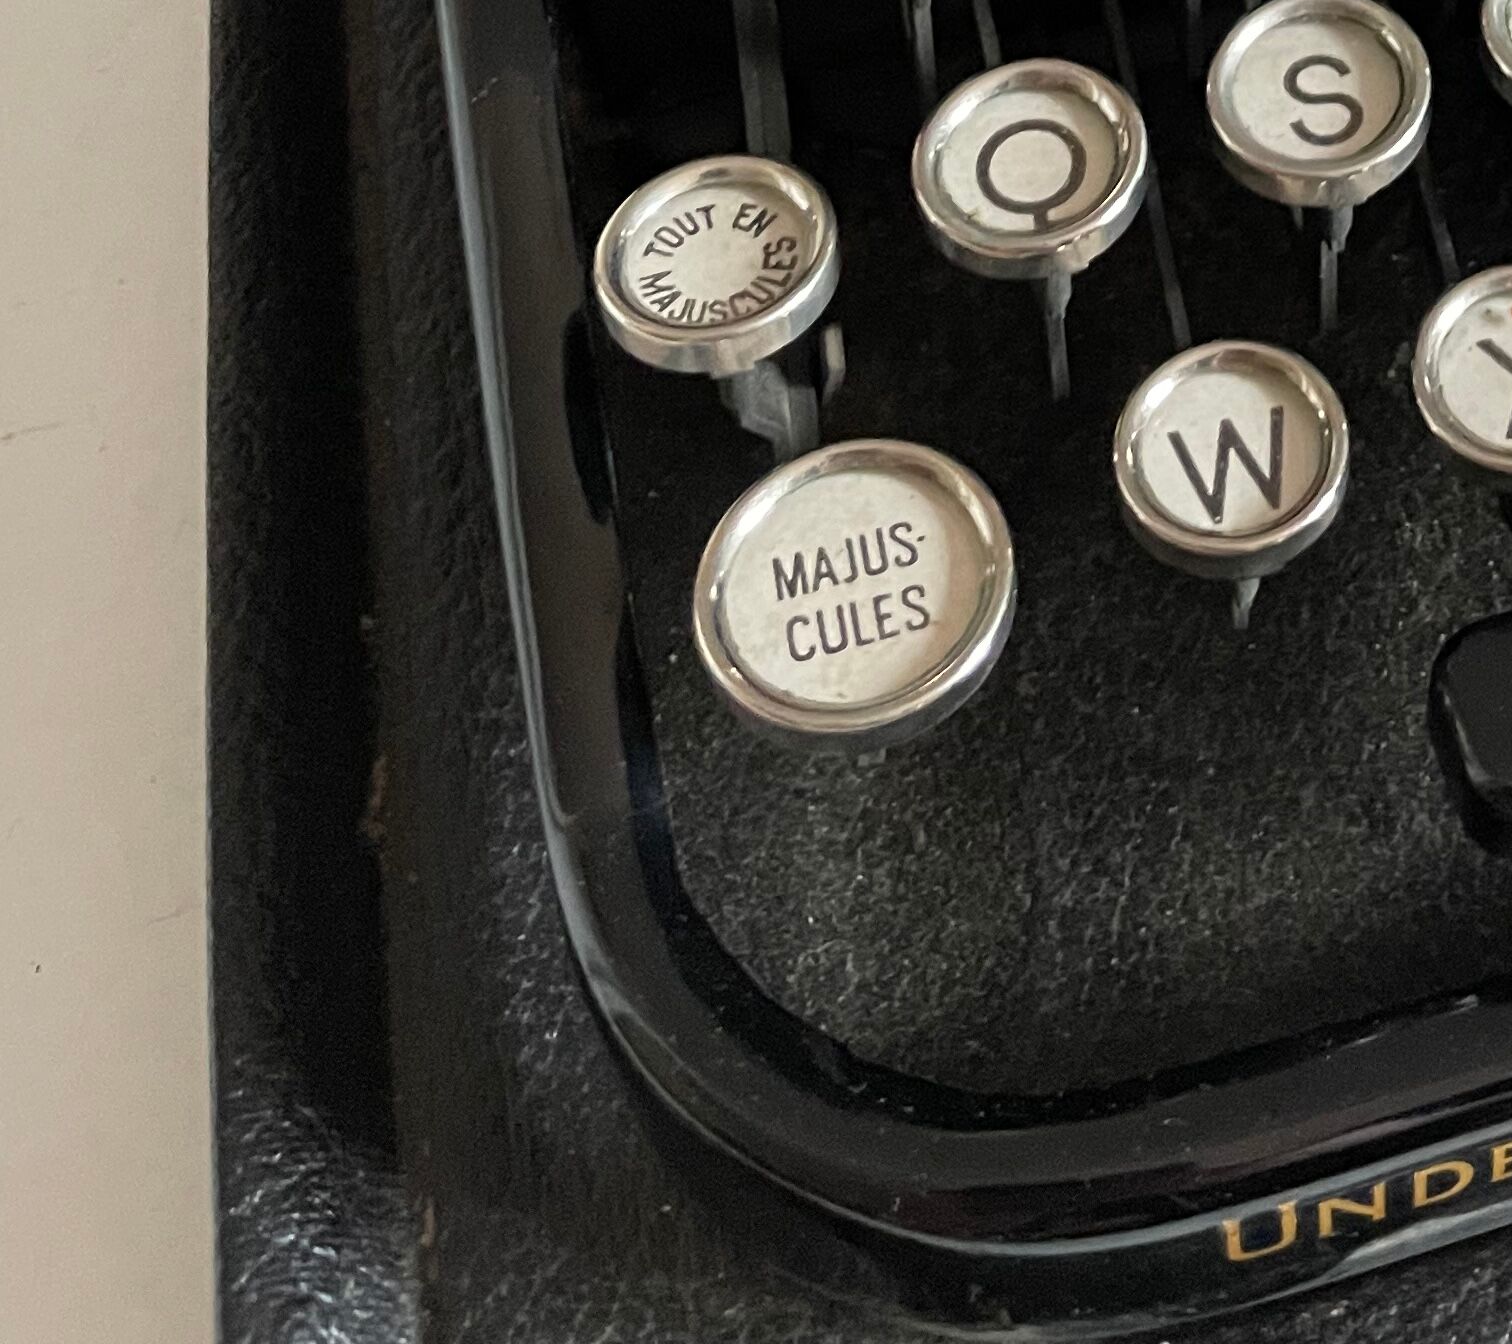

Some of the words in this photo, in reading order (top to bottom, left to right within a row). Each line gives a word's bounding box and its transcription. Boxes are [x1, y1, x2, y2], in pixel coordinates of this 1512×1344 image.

[1283, 55, 1364, 146] S
[976, 118, 1087, 230] Q
[643, 204, 717, 258] TOUT
[732, 202, 778, 239] EN
[639, 234, 798, 324] MAJUSCULES
[1168, 404, 1284, 525] W
[786, 584, 930, 662] CULES
